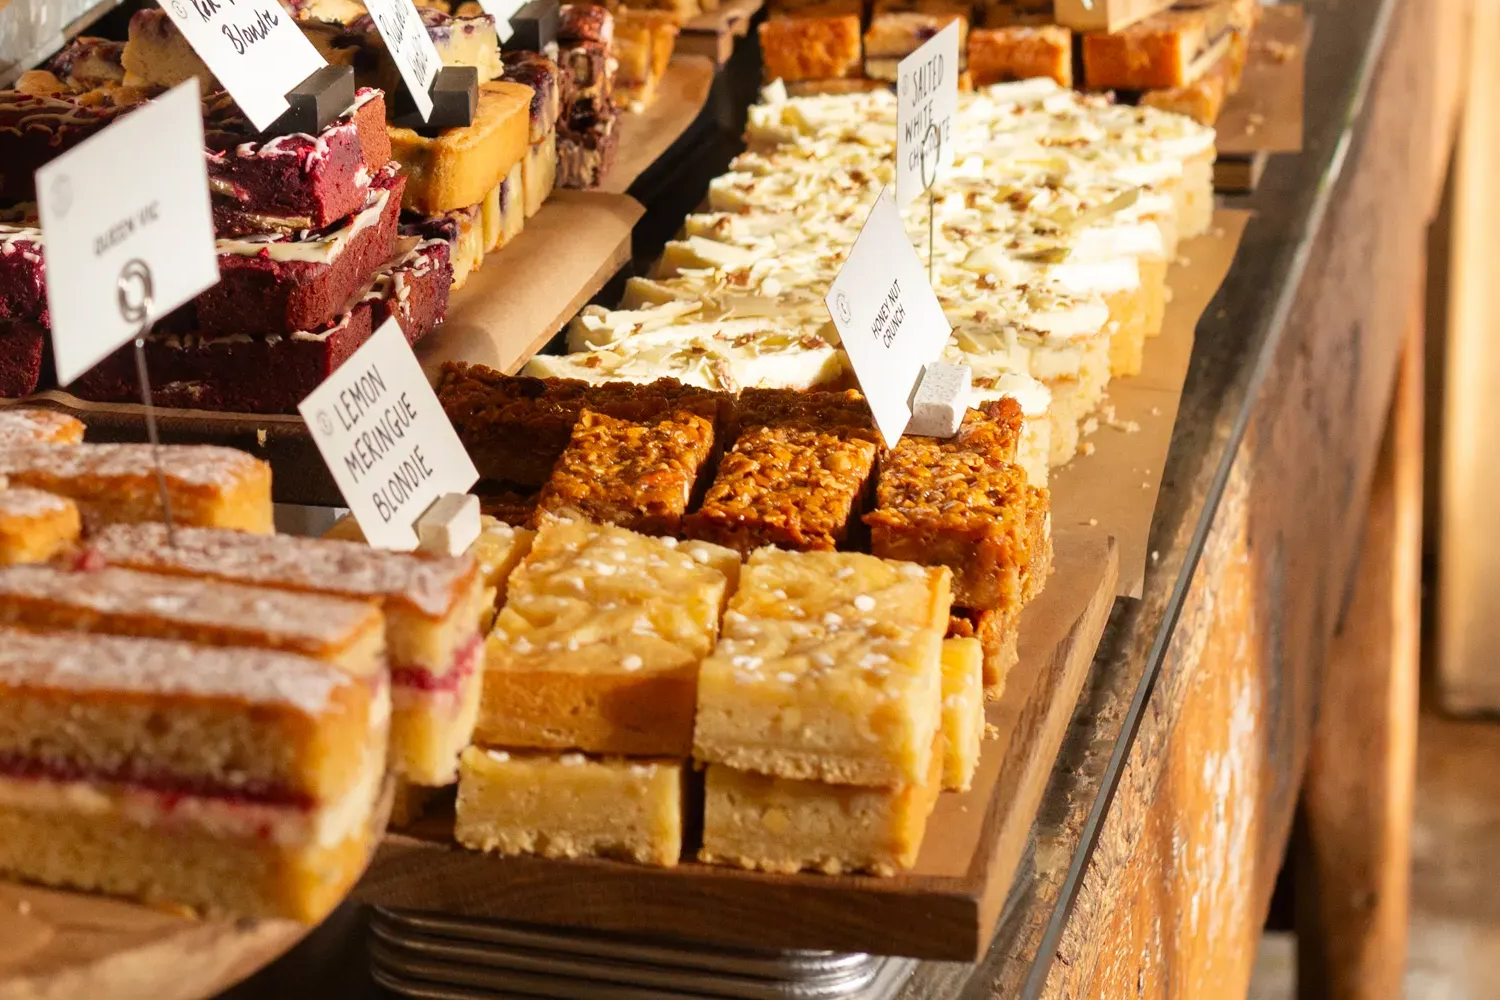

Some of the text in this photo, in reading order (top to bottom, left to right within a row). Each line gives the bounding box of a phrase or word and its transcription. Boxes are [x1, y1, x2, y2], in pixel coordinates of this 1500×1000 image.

[221, 8, 279, 56] Blondie
[912, 53, 945, 108] SALTED
[905, 99, 934, 144] WHITE
[93, 216, 135, 257] QUEEN
[870, 278, 904, 340] HONEY NUT
[882, 303, 907, 349] CRUNCH
[333, 362, 387, 432] LEMON
[343, 392, 418, 484] MERINGUE
[371, 444, 434, 524] BLONDIE
